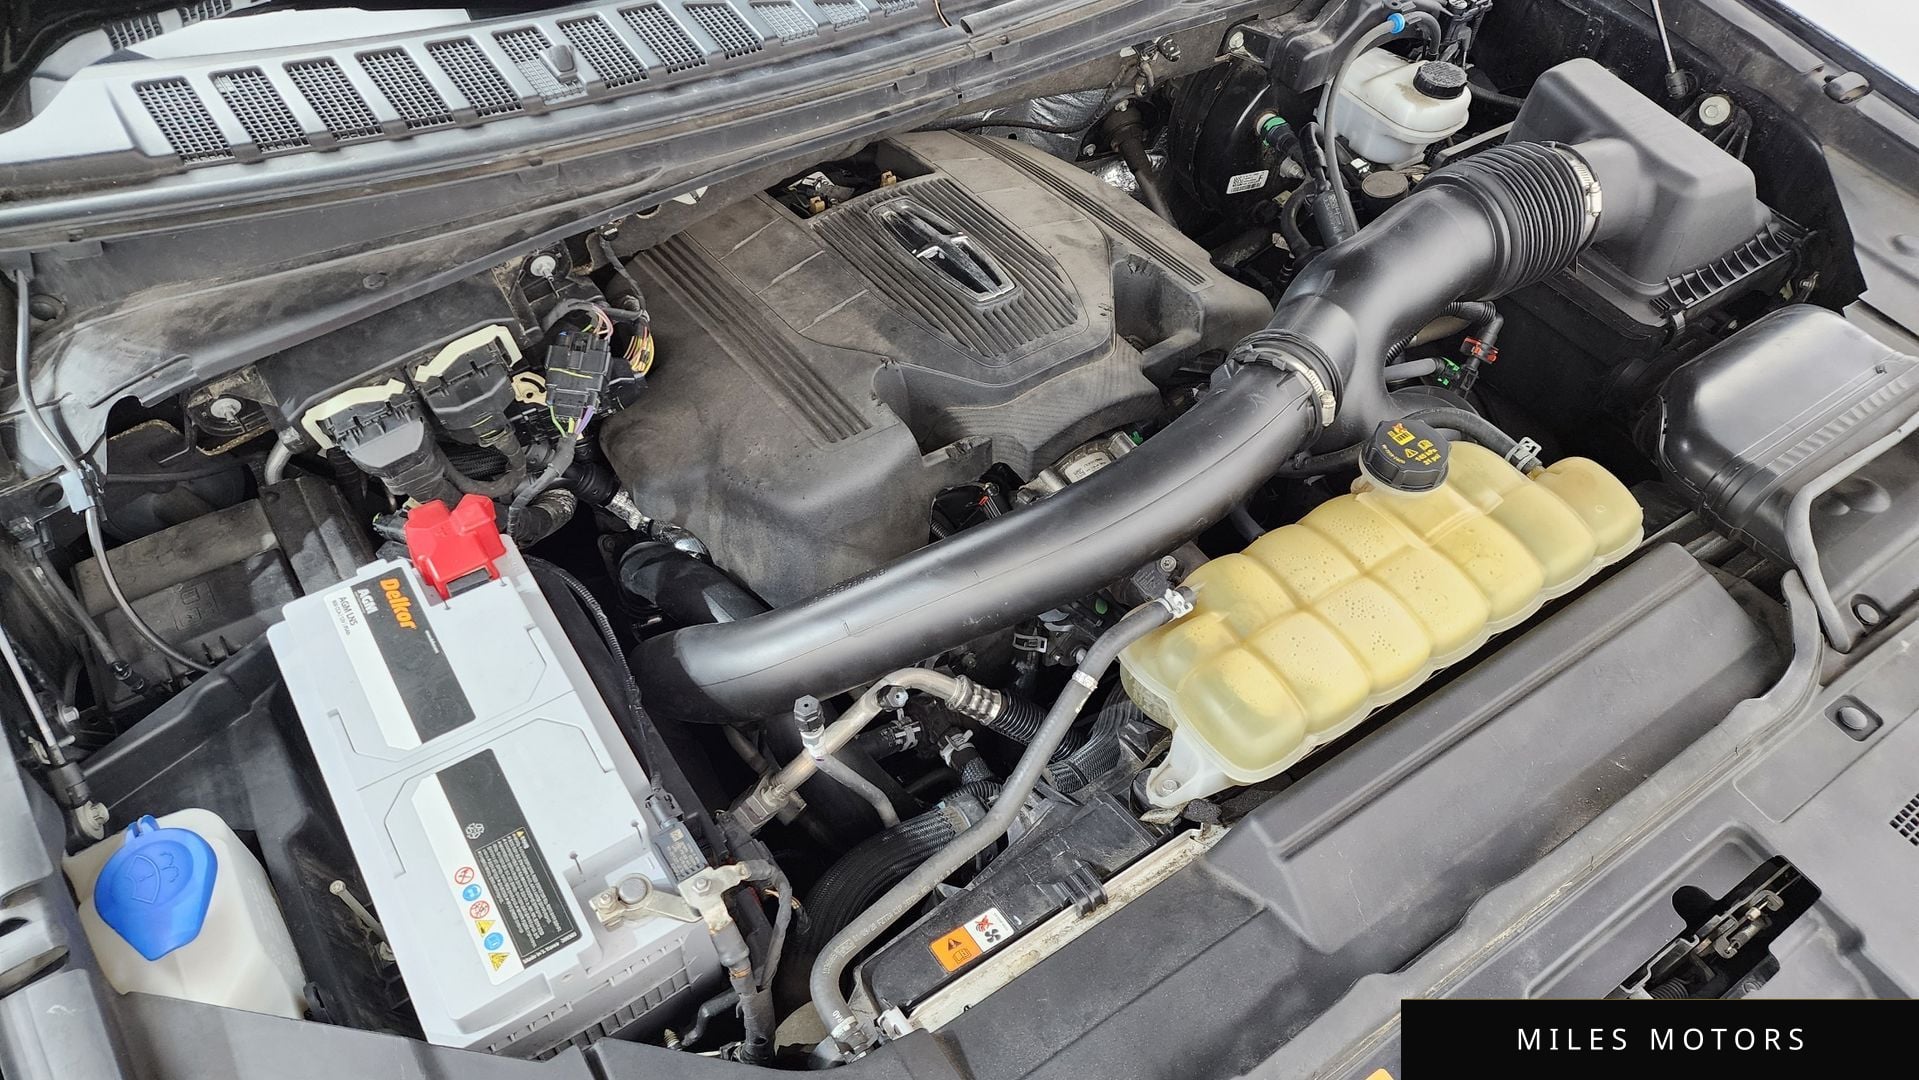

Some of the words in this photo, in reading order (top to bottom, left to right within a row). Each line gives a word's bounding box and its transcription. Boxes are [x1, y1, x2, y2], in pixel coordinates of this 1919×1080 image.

[338, 596, 352, 614] AGM
[357, 589, 379, 615] AGM
[380, 578, 417, 630] Delkor
